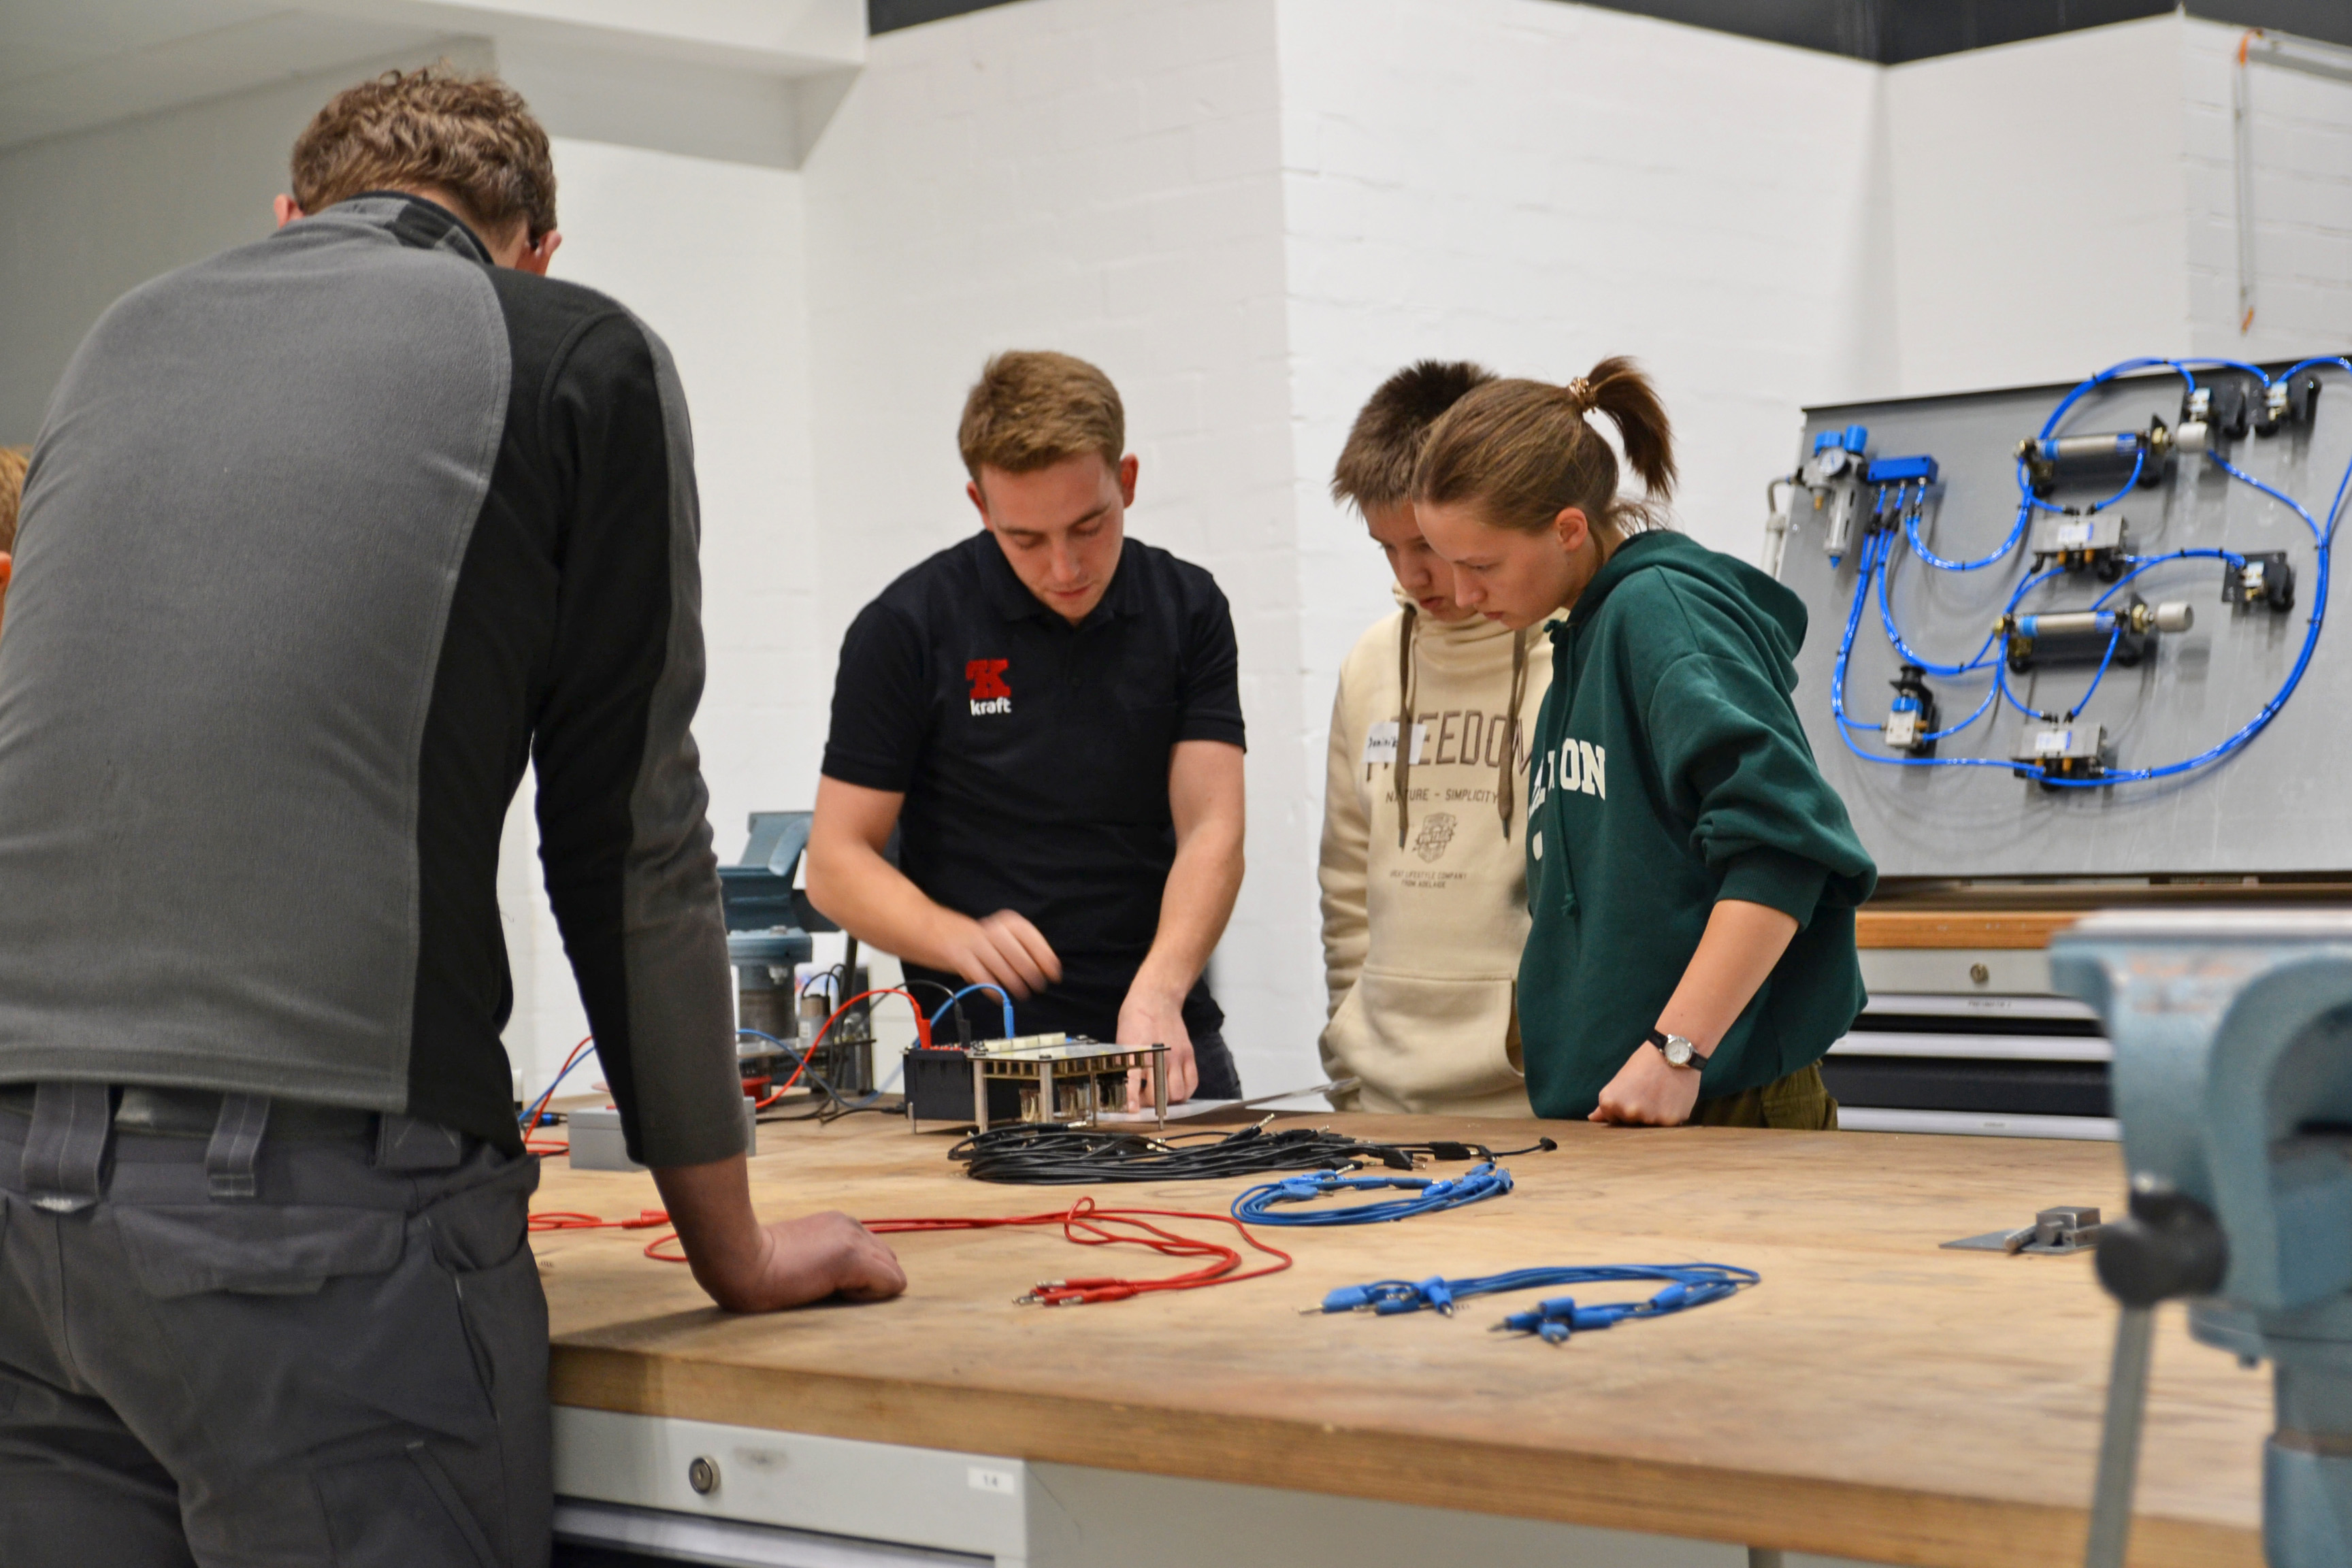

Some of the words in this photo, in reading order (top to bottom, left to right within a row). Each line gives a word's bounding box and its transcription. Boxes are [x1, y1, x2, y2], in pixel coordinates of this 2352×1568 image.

[970, 697, 1011, 715] kraft
[1367, 710, 1533, 782] EEDO
[1386, 789, 1428, 803] NURE
[1445, 788, 1498, 804] SIMPLICITY
[1437, 872, 1467, 880] COMPANY
